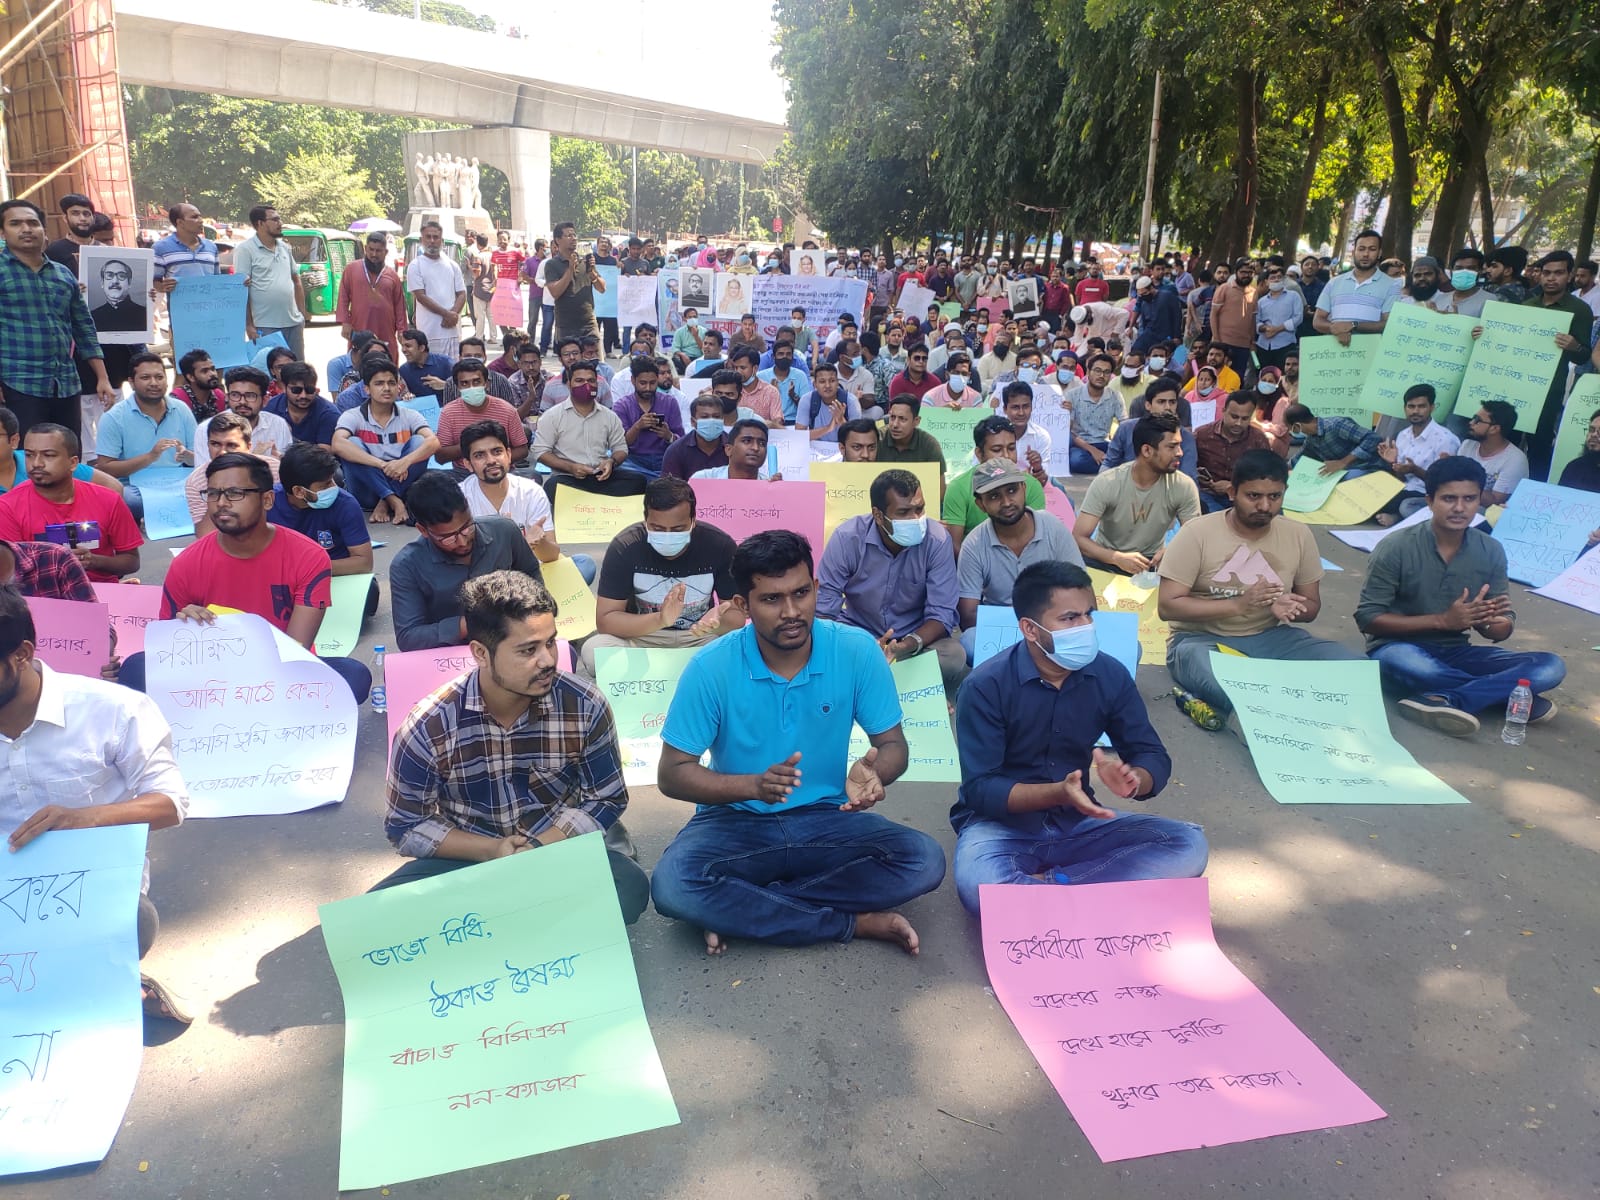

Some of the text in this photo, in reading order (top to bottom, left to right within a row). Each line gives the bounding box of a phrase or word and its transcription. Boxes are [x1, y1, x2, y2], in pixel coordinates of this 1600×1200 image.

[169, 679, 228, 709] আমি
[1000, 929, 1172, 965] মেধাবীরা রাজপথে
[428, 953, 580, 1018] ঠেকাও বৈষম্য
[1028, 989, 1100, 1010] এদেশের
[389, 1021, 575, 1067] বাঁচাও বিসিএস
[1057, 1034, 1104, 1055] দেখে
[1108, 1029, 1152, 1048] হাসে
[1169, 1077, 1215, 1095] তার
